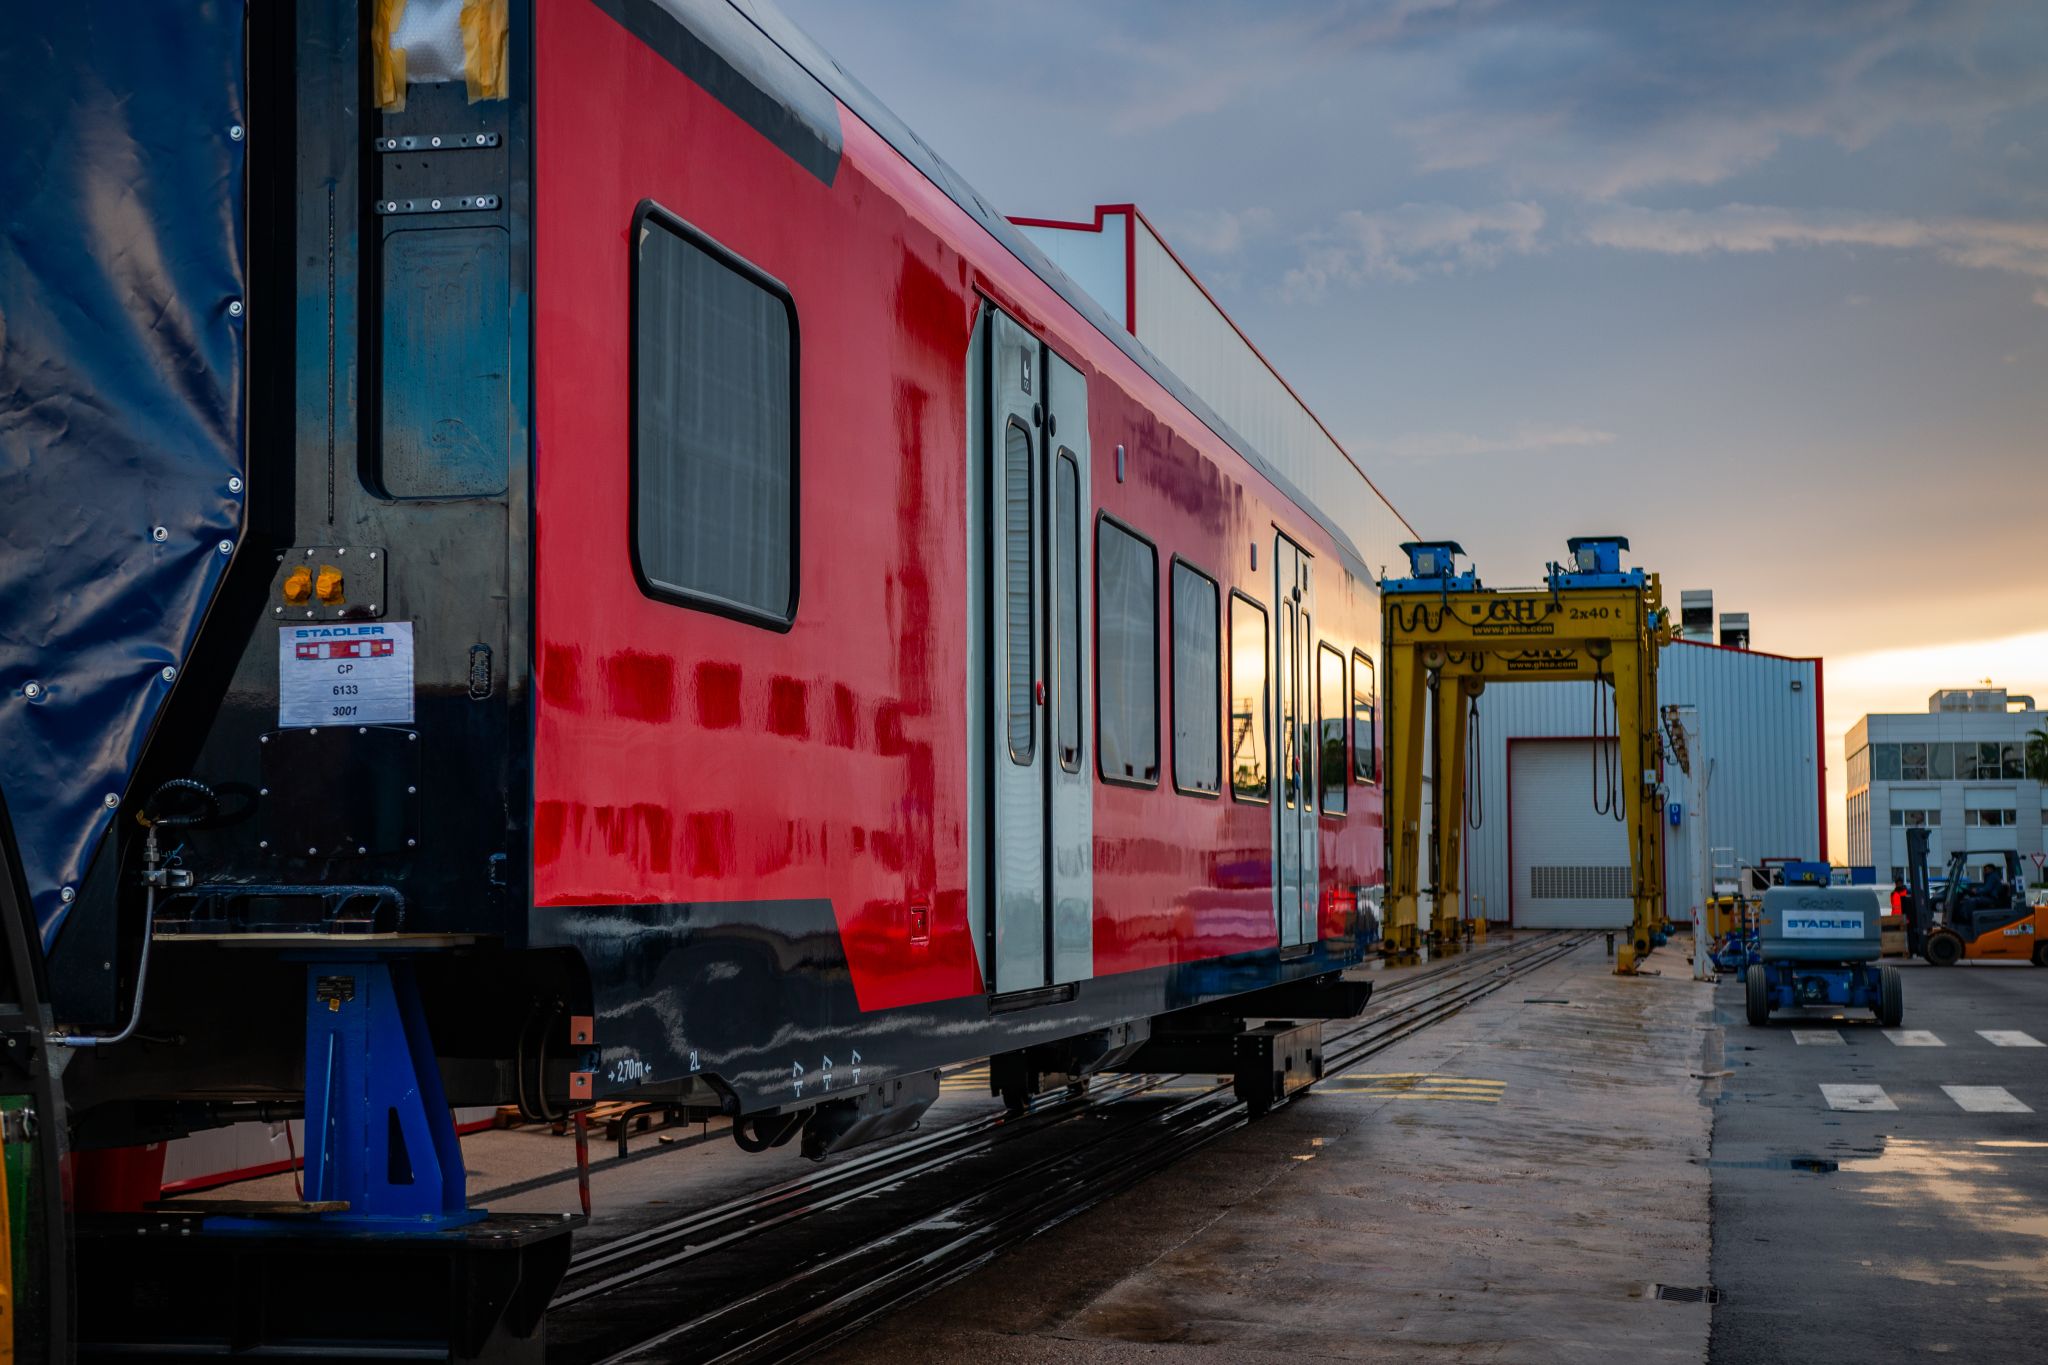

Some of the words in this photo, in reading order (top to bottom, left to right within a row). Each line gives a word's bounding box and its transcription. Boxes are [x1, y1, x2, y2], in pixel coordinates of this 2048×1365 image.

[1489, 599, 1535, 621] GH
[1569, 607, 1609, 620] 2x40
[1614, 608, 1622, 619] t
[296, 626, 384, 638] STADLER
[1474, 625, 1552, 634] www.ghsa.com
[337, 664, 353, 674] CP
[332, 685, 358, 695] 6133
[332, 706, 357, 716] 3001
[1788, 920, 1861, 928] STADLER
